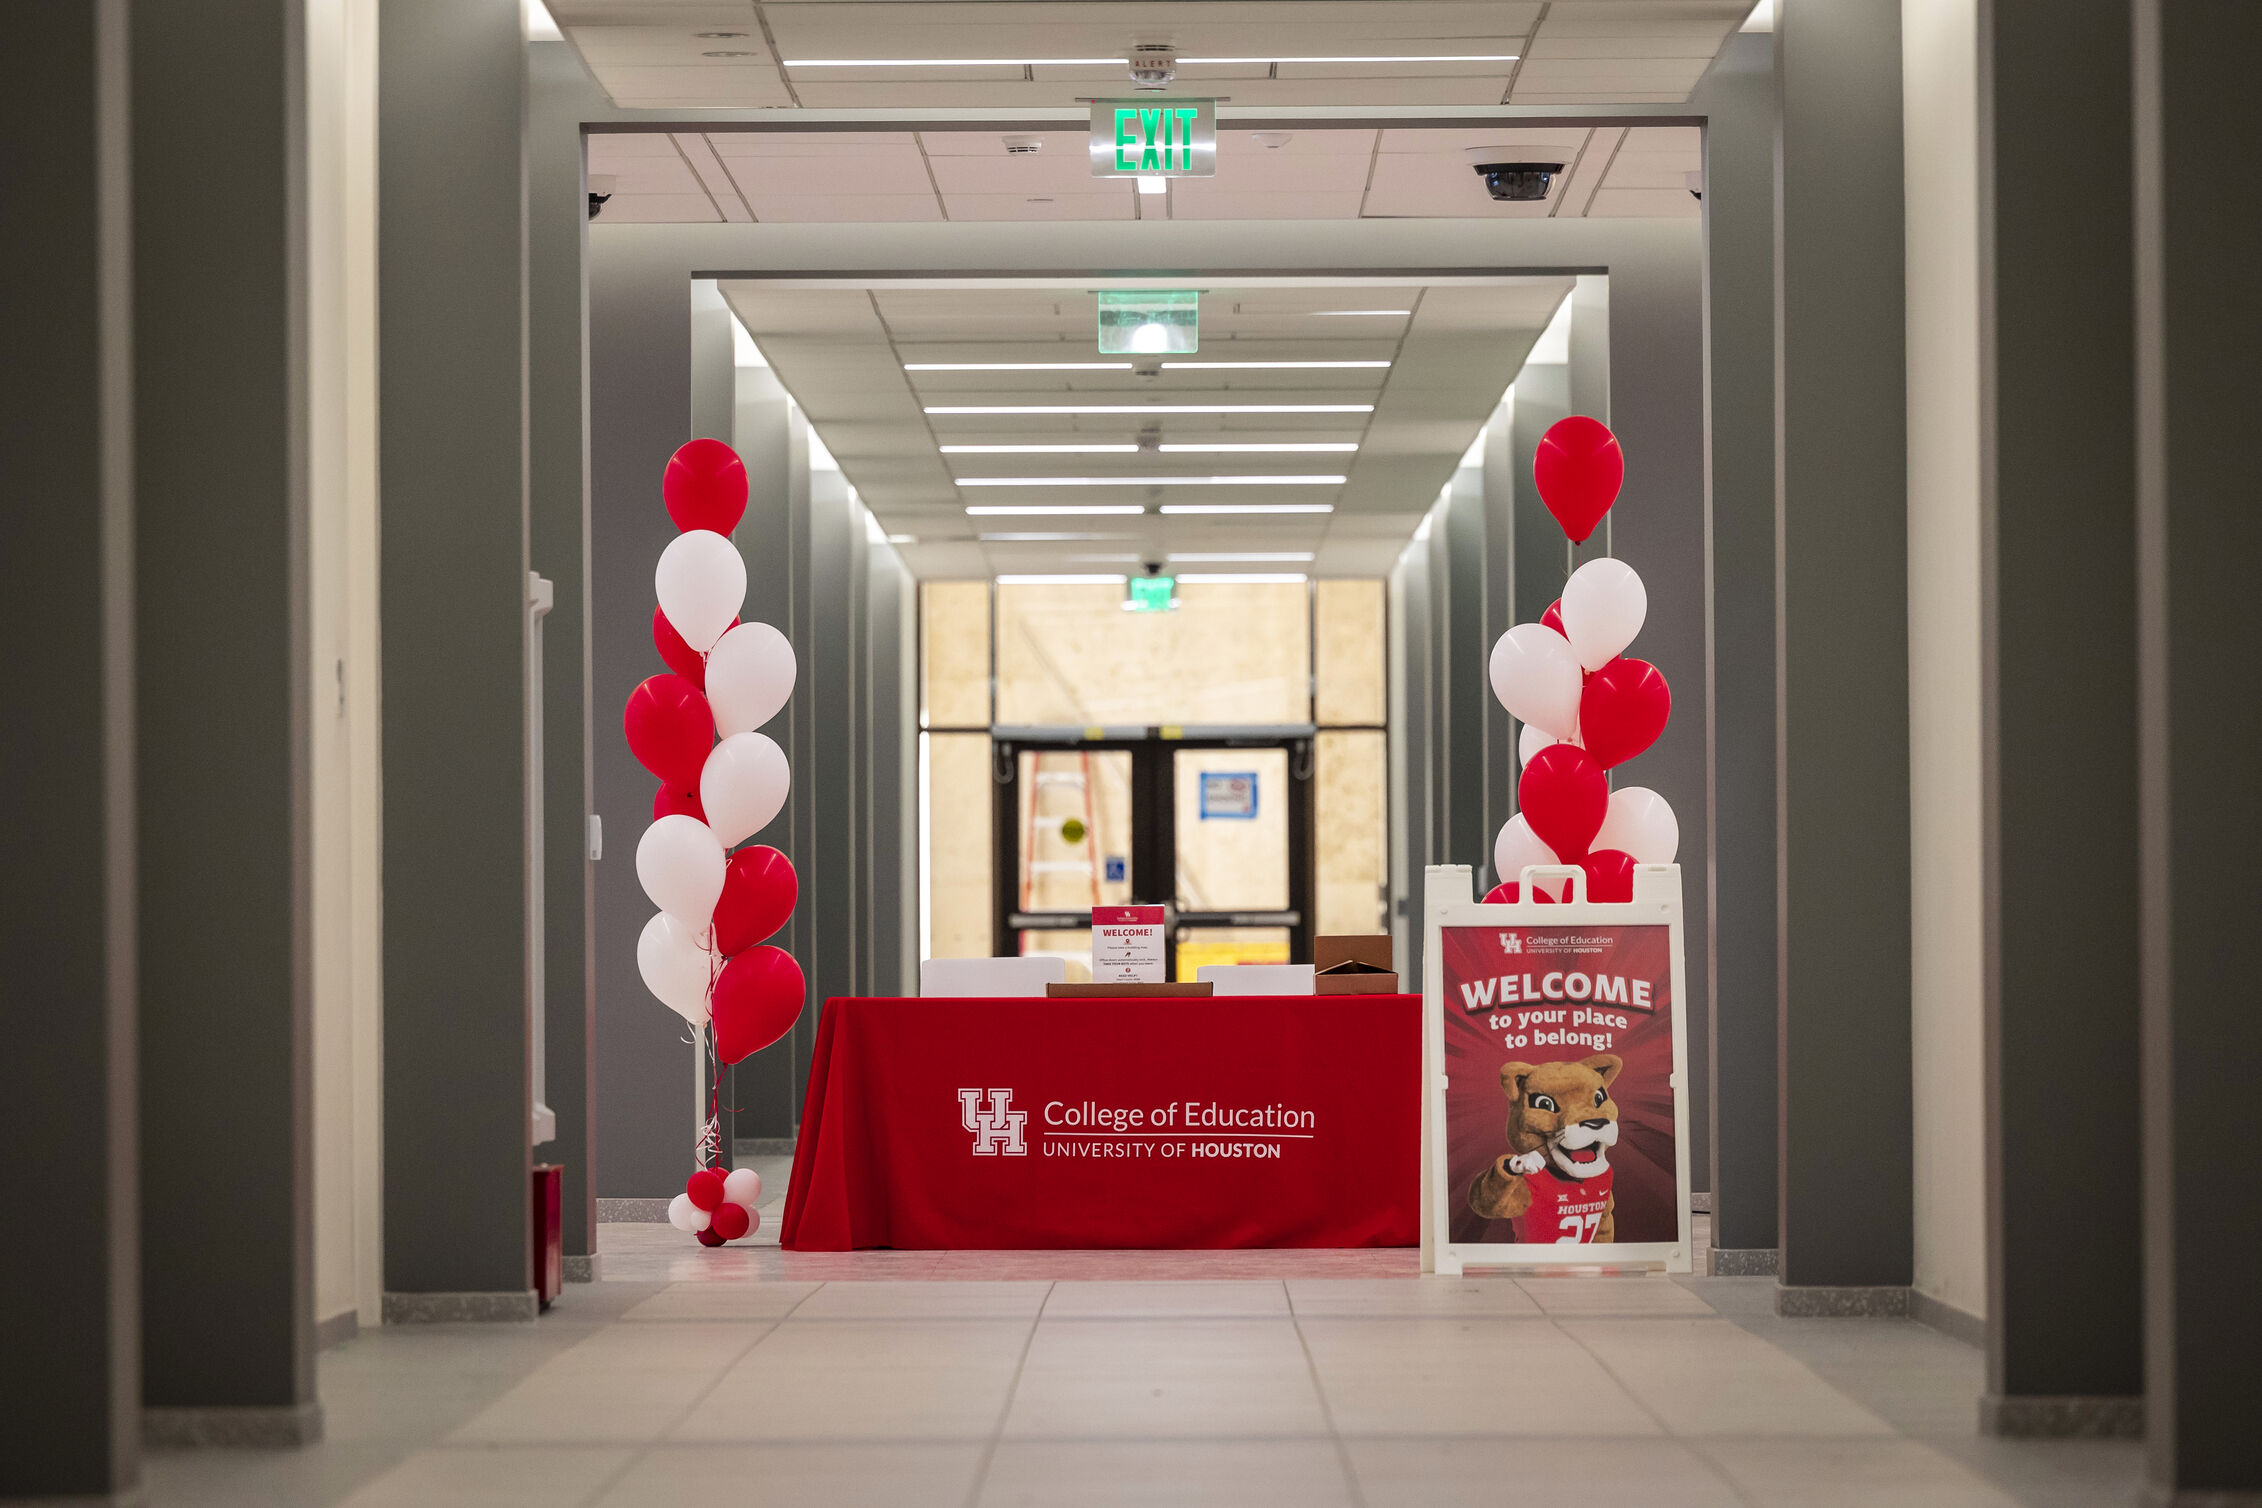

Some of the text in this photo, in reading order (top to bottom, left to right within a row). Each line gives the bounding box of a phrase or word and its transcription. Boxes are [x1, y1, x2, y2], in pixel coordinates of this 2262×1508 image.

[1115, 108, 1198, 171] EXIT
[1103, 928, 1153, 937] WELCOME!
[1526, 936, 1614, 946] College of Education
[1460, 971, 1651, 1009] WELCOME
[1489, 1007, 1628, 1030] to your place
[1505, 1028, 1613, 1051] to belong!
[1044, 1101, 1315, 1131] College of Education
[1043, 1142, 1281, 1159] UNIVERSITY OF HOUSTON
[1557, 1200, 1607, 1215] HOUSTON
[1556, 1212, 1603, 1243] 27
